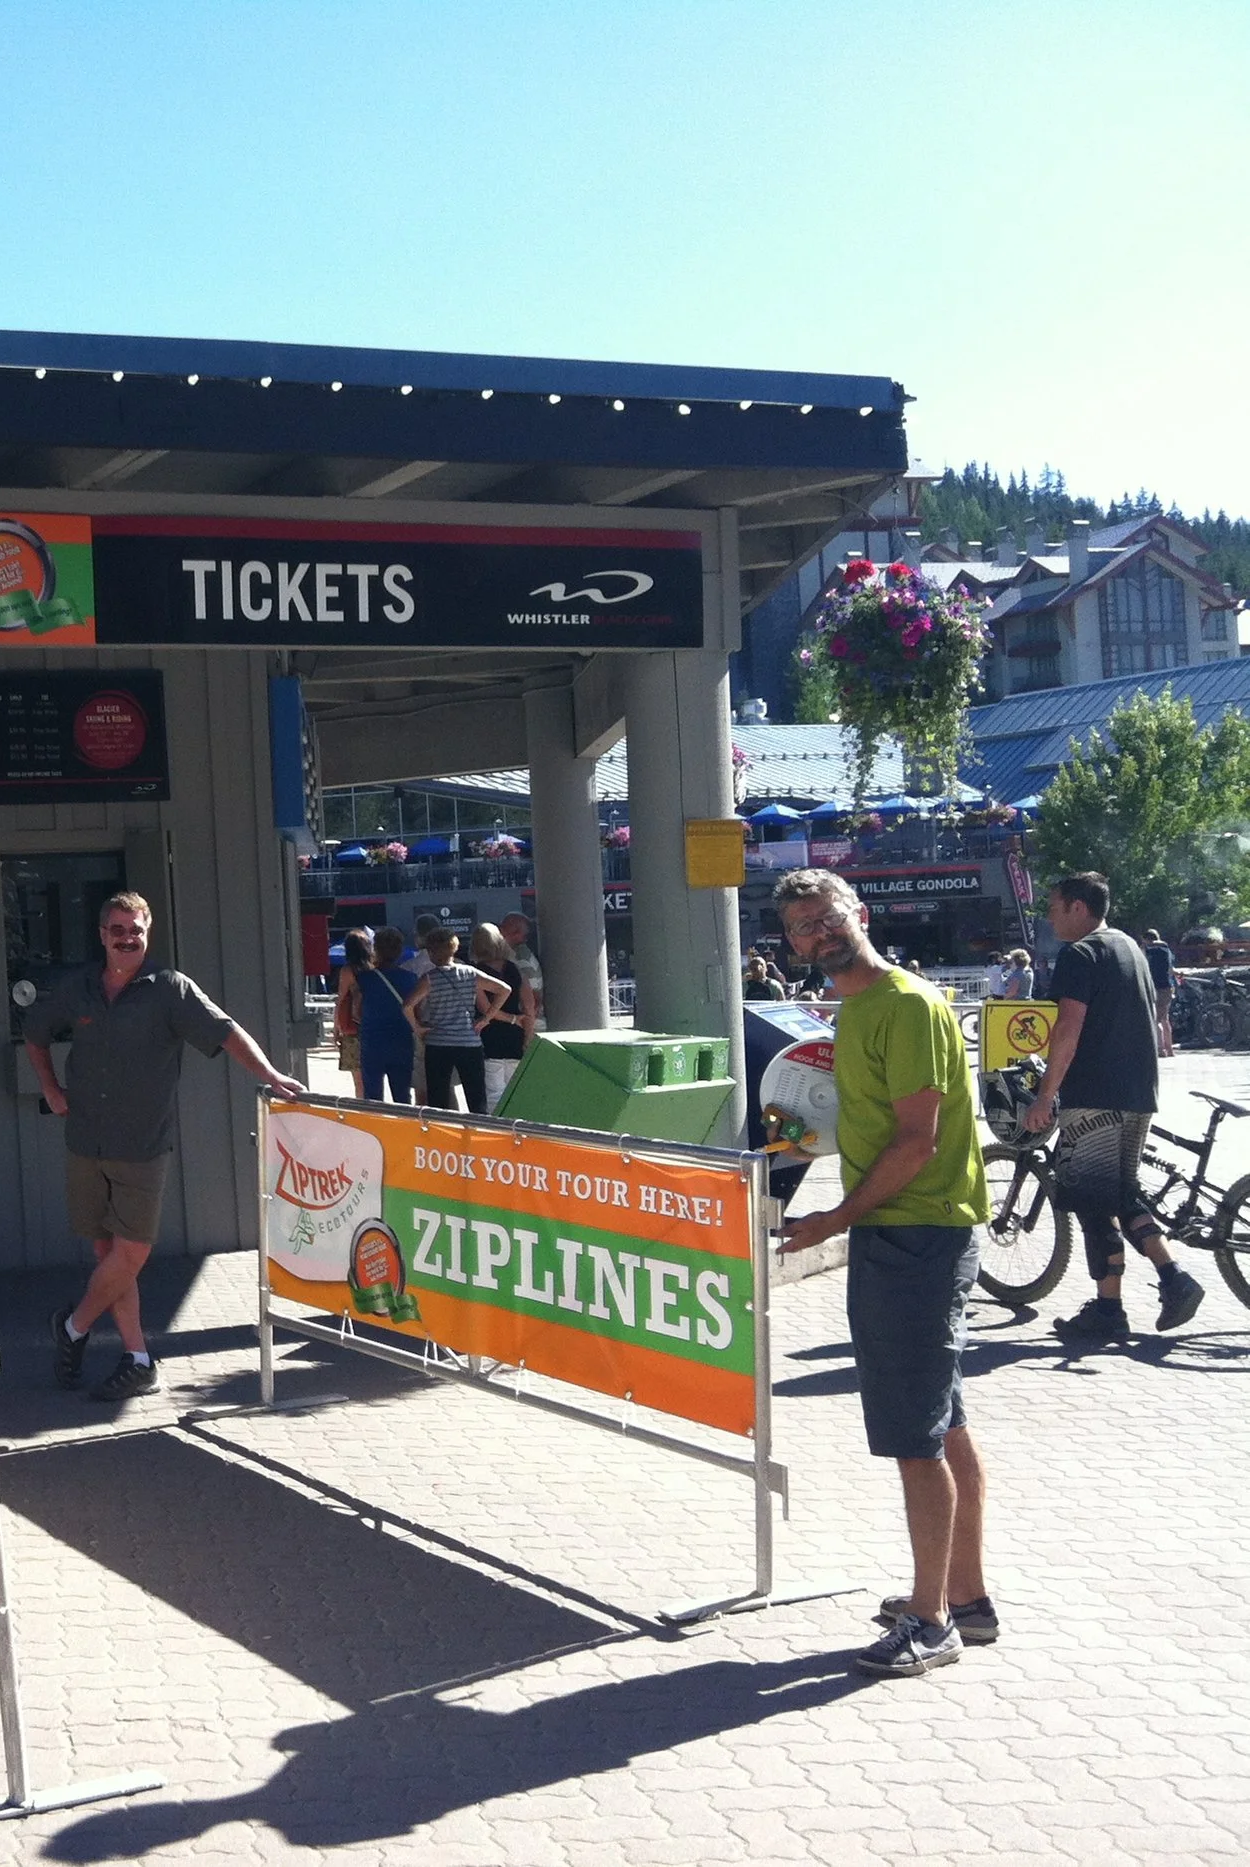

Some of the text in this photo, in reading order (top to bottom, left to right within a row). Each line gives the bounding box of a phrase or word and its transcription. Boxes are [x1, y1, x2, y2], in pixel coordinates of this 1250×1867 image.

[182, 559, 415, 624] TICKETS
[507, 613, 590, 625] WHISTLER
[96, 705, 120, 713] GLACIER
[861, 880, 914, 894] VILLAGE
[917, 877, 979, 891] GONDOLA
[872, 904, 885, 914] TO
[276, 1138, 353, 1210] ZIPTREK
[318, 1168, 369, 1235] ECOTOURS
[414, 1145, 723, 1227] BOOK YOUR TOUR HERE!
[412, 1207, 733, 1351] ZIPLINES
